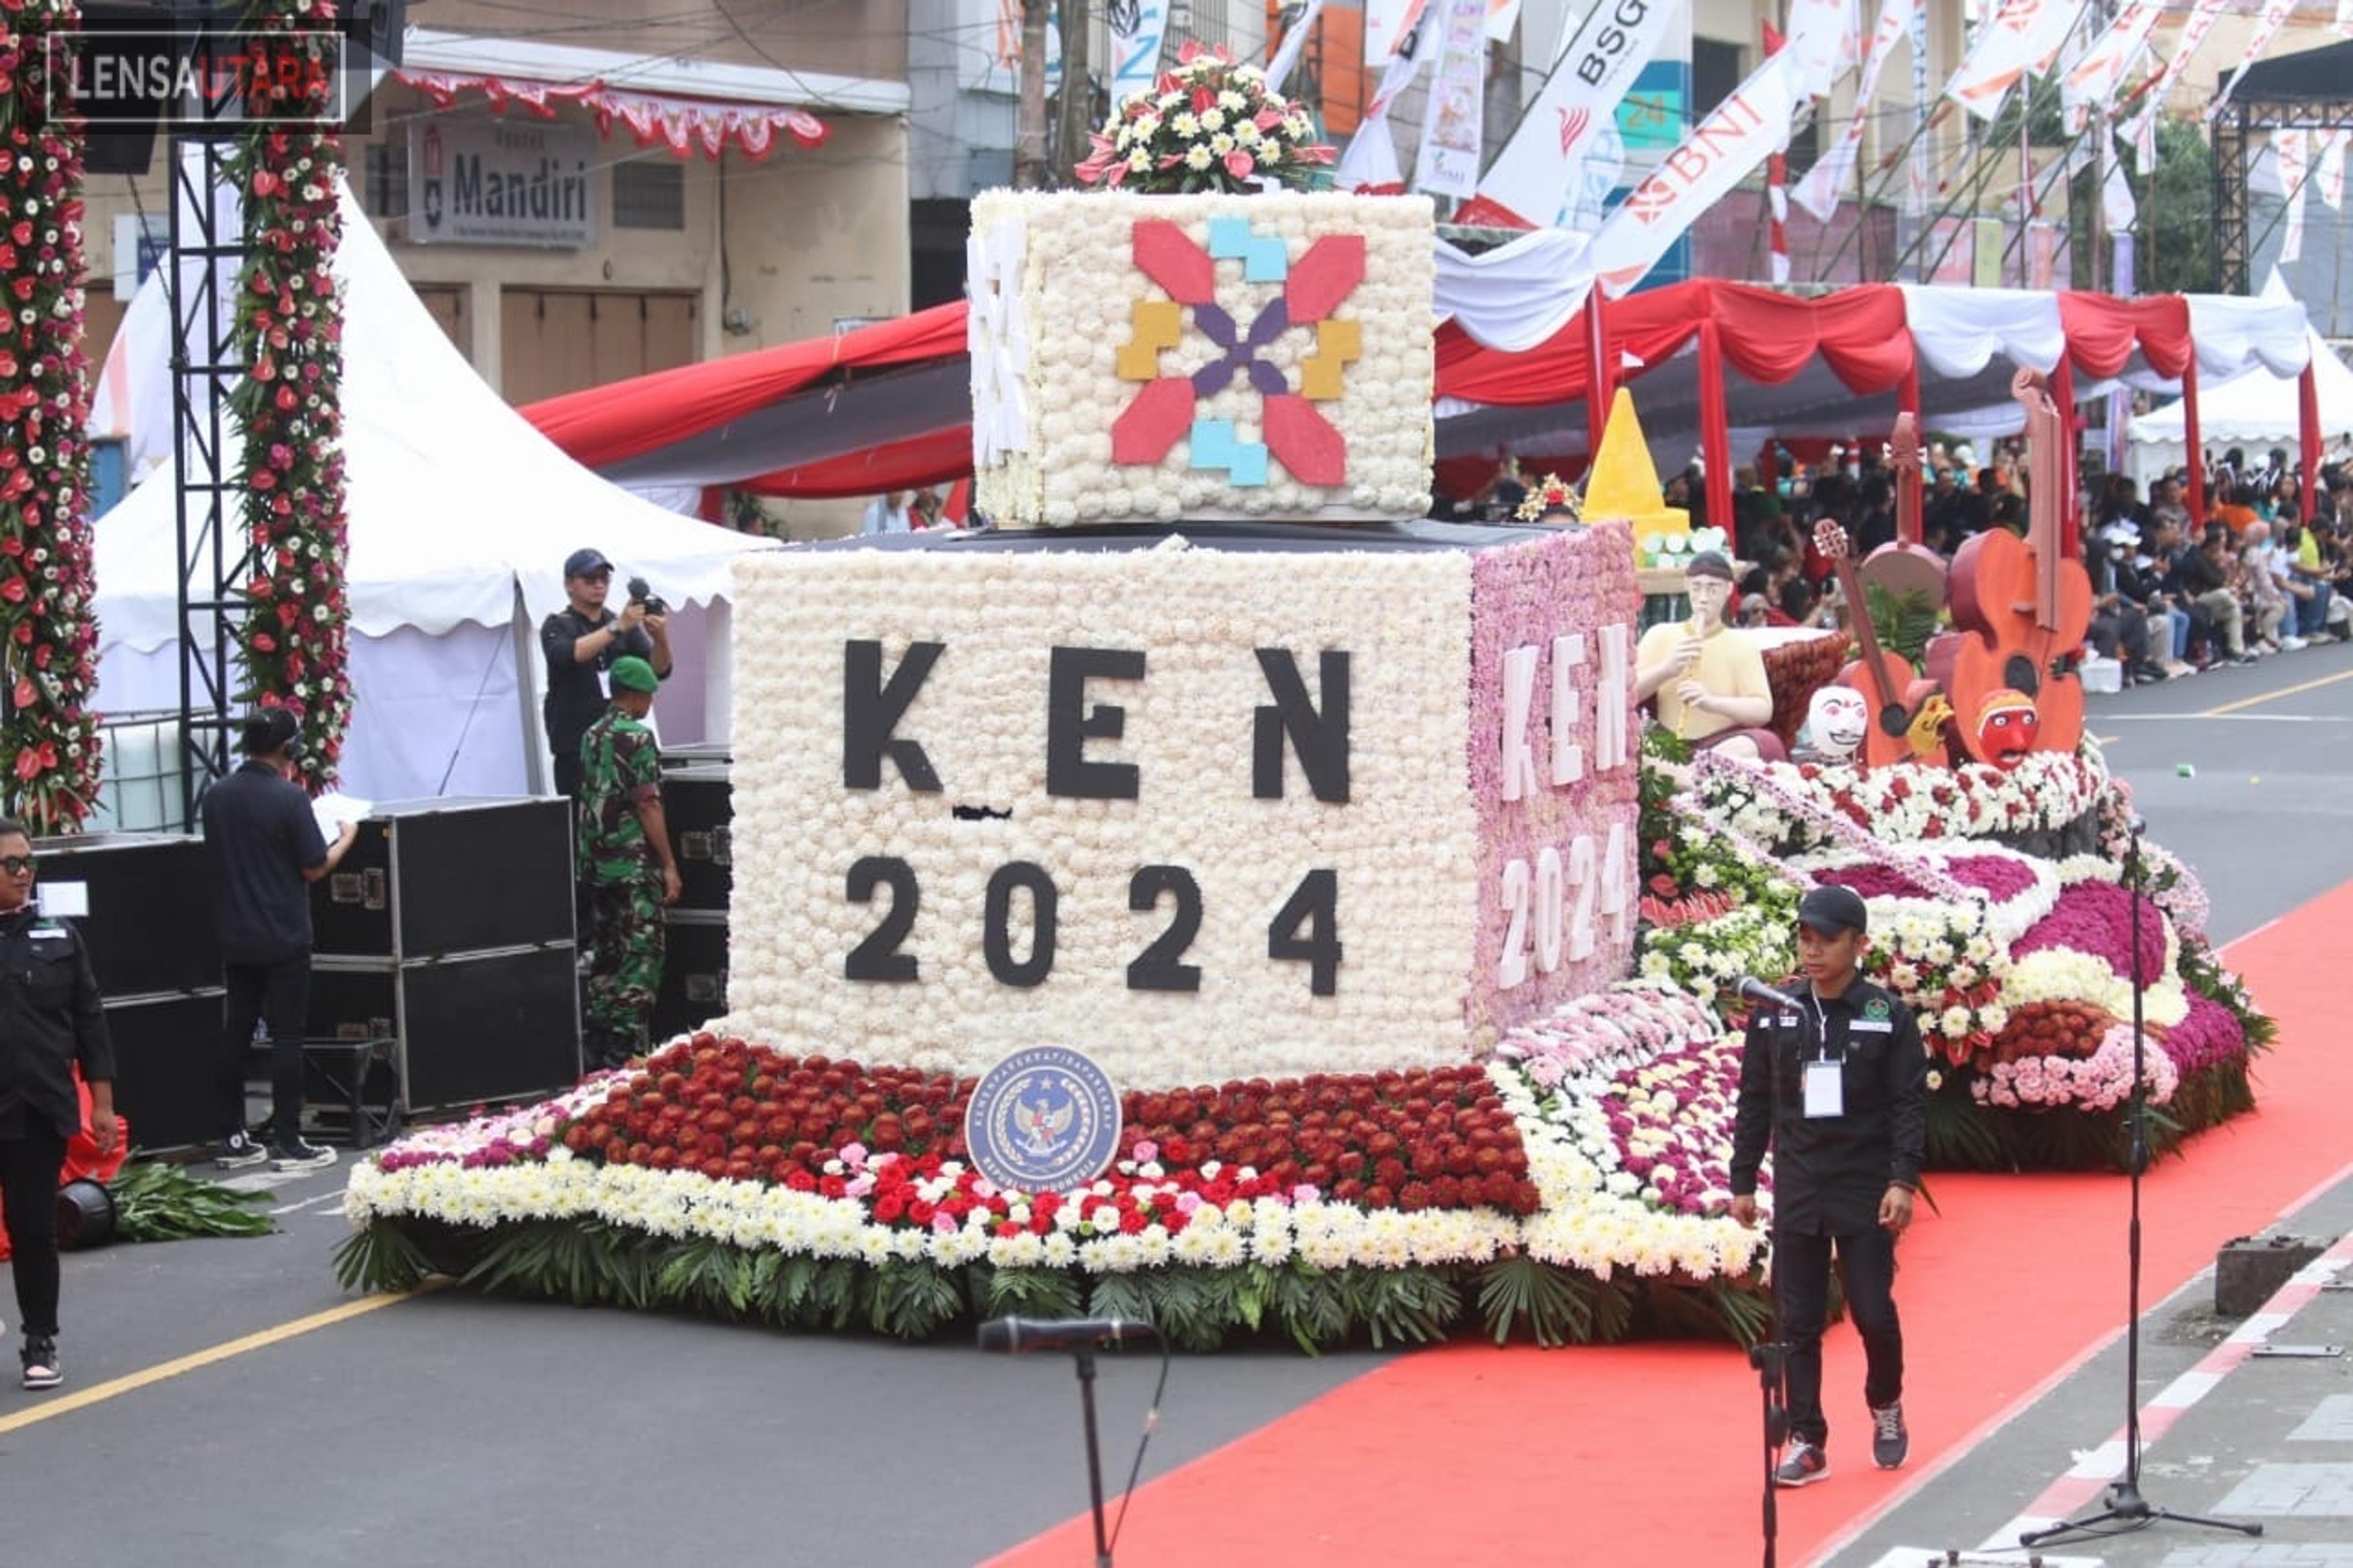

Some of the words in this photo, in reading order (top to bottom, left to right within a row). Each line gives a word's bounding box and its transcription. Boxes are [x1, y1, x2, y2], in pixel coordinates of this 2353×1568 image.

[1577, 0, 1648, 86] BSG
[1665, 94, 1764, 184] BNI
[454, 154, 585, 221] Mandiri
[845, 856, 1343, 996] 2024
[1499, 822, 1626, 990] 2024
